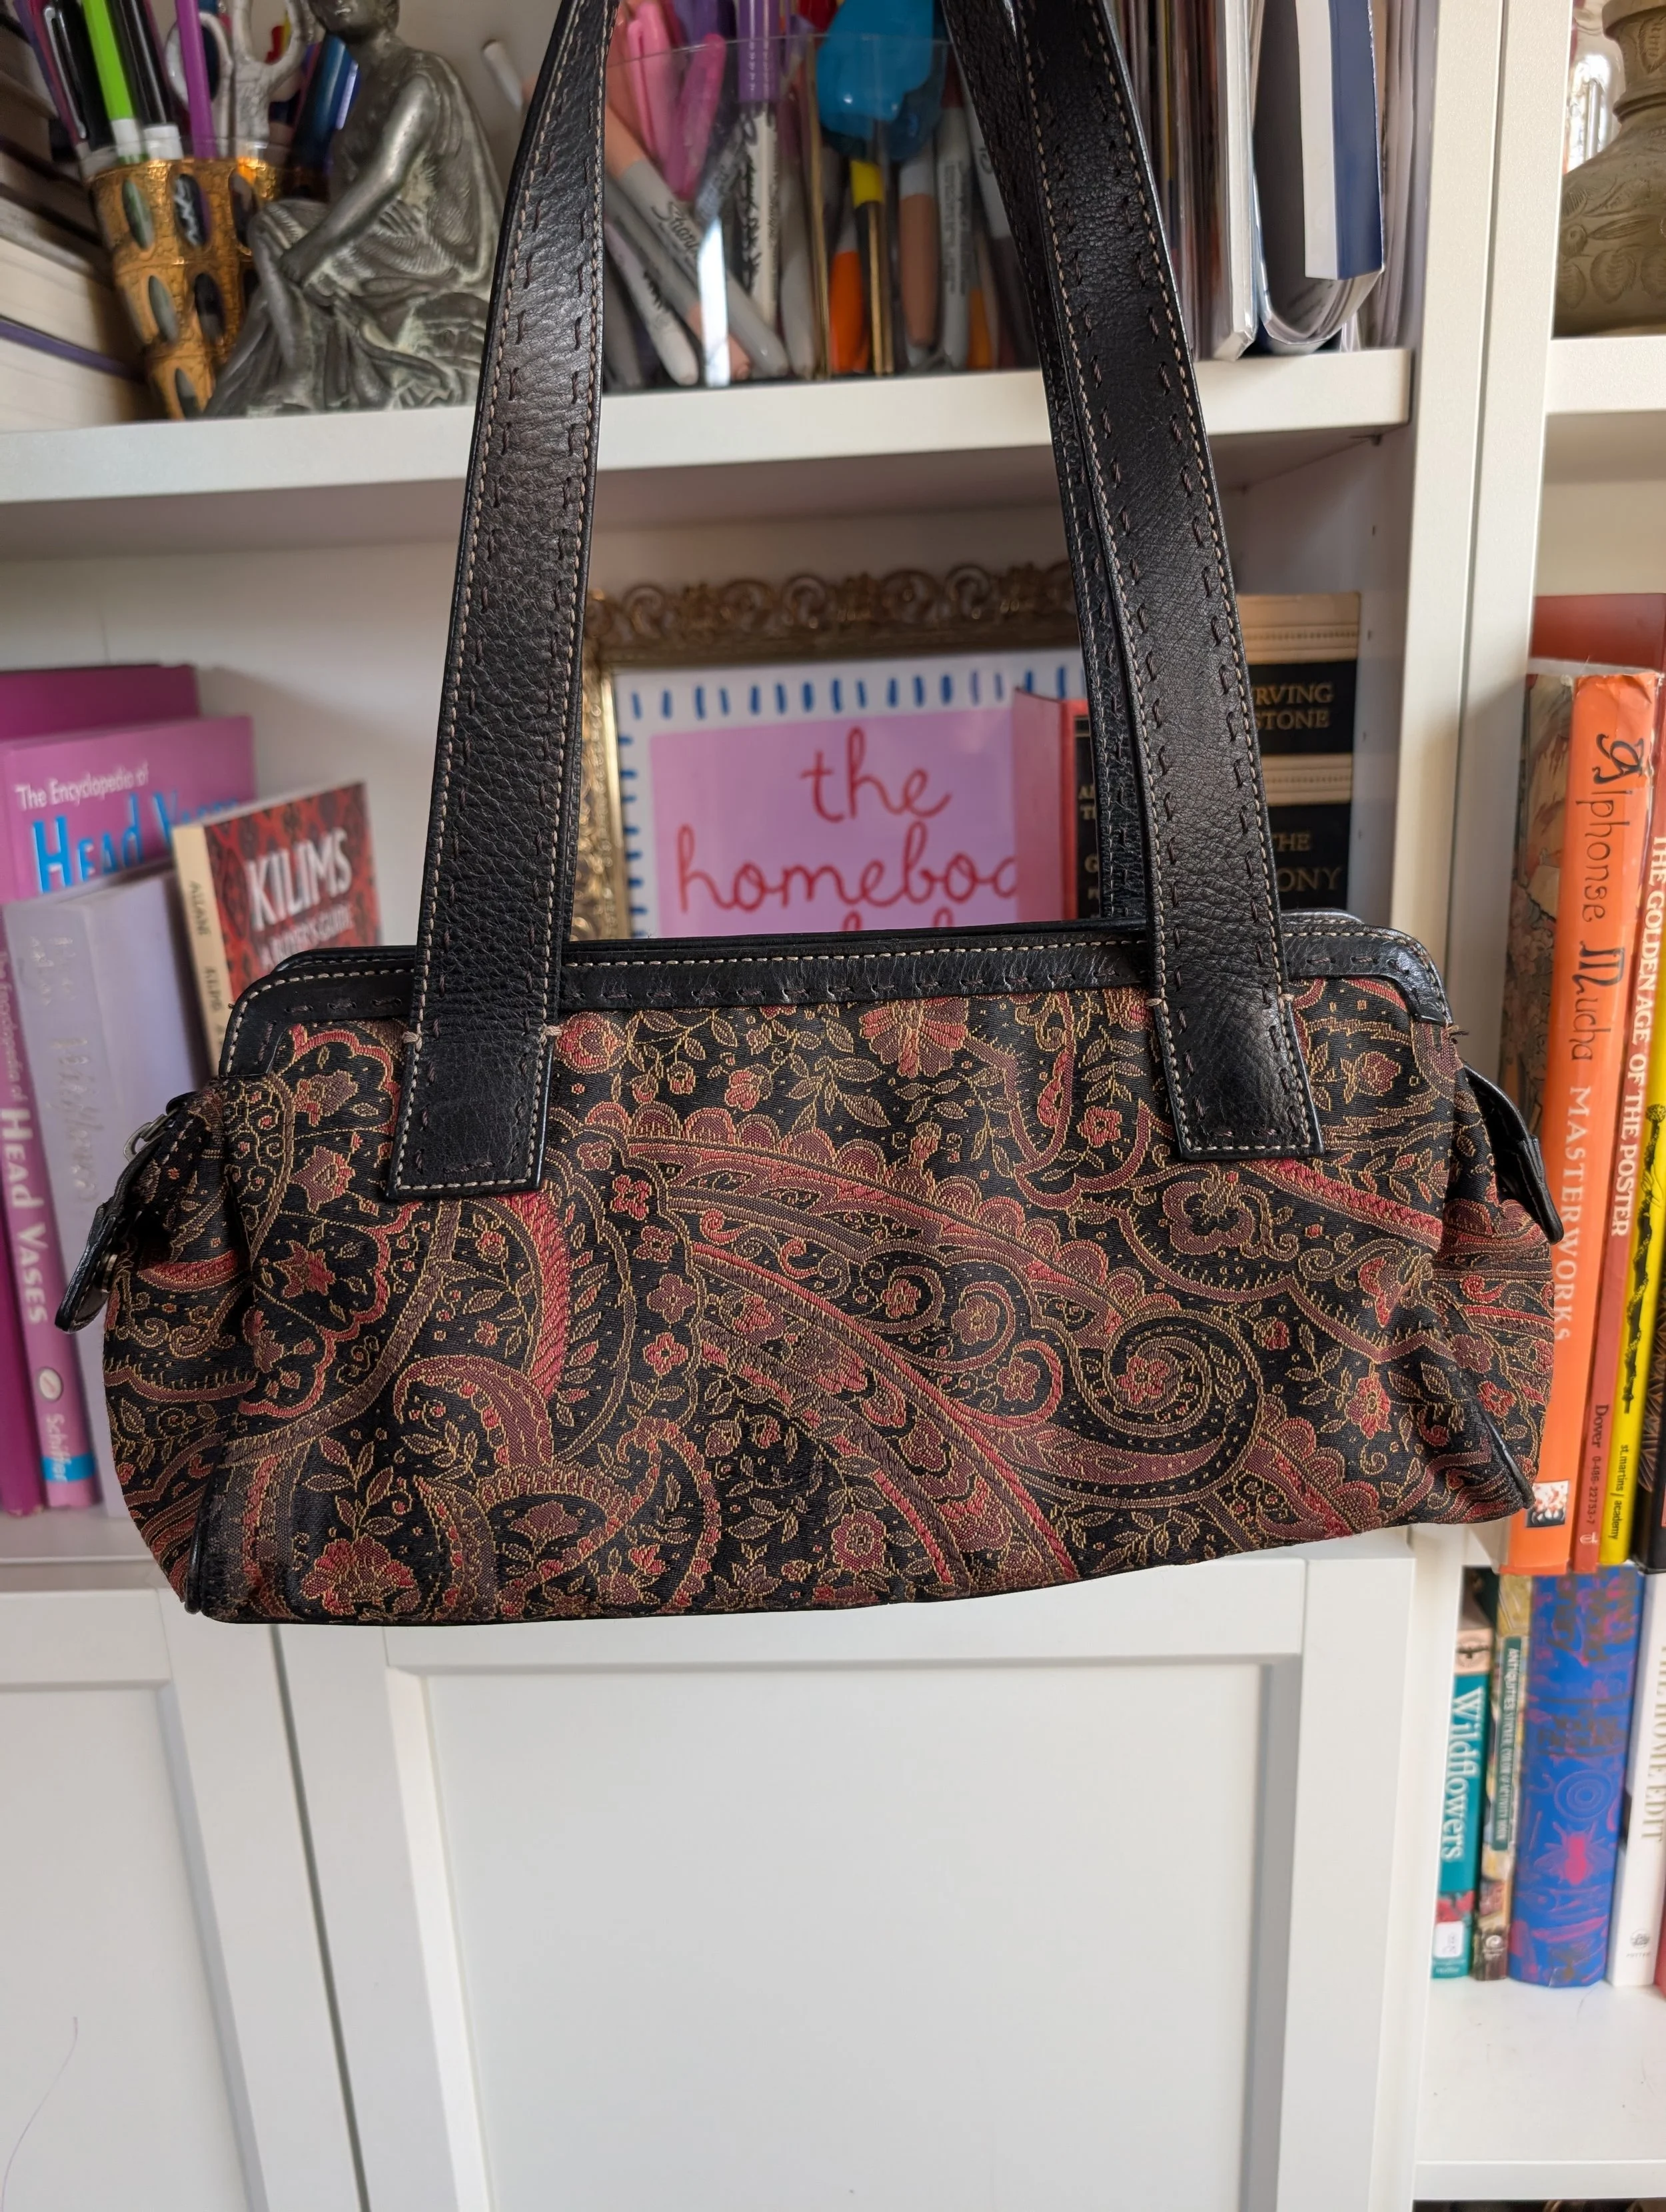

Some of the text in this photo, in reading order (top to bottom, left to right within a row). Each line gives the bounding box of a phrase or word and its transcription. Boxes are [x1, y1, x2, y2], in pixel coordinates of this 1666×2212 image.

[1254, 682, 1333, 705] RVING
[15, 758, 149, 811] The Encyclopedia of
[802, 726, 952, 822] the
[245, 826, 353, 933] KILIMS
[1277, 866, 1342, 891] ONY
[1638, 890, 1665, 991] GOLDEN
[1554, 734, 1645, 1341] Alphonse Mucha MASTERWORKS
[1632, 995, 1654, 1045] AGE
[1628, 1053, 1647, 1086] OF
[1620, 1089, 1644, 1141] THE
[1611, 1144, 1638, 1237] POSTER
[1591, 1403, 1609, 1448] Dover
[1607, 1499, 1623, 1540] academy
[1440, 1686, 1485, 1863] Wildflowers
[1641, 1785, 1665, 1842] EDIT
